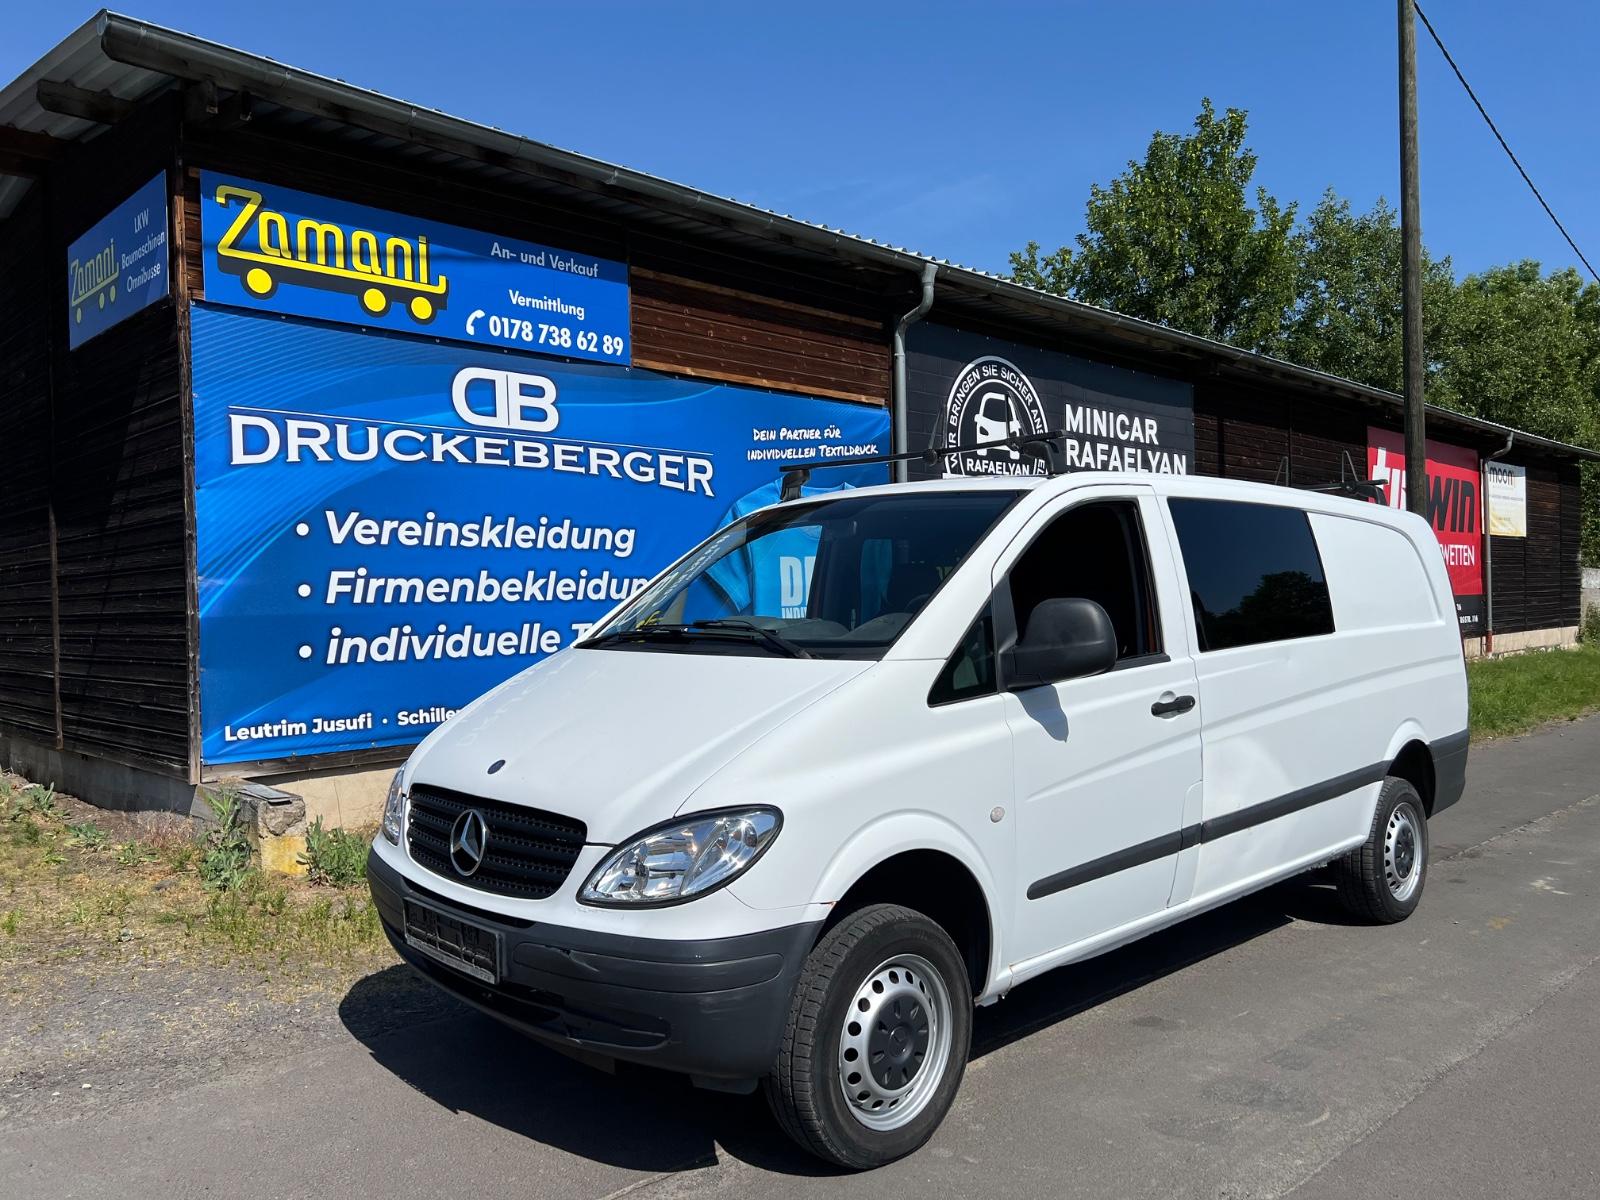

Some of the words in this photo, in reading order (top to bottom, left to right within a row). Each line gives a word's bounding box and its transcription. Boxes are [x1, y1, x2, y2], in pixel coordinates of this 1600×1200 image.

[134, 208, 149, 233] LKW
[216, 184, 446, 294] Zamani
[121, 231, 165, 269] Baumaschinen
[490, 242, 517, 260] An-
[520, 251, 545, 267] und
[549, 254, 599, 278] Verkauf
[71, 238, 119, 306] Zamani
[126, 262, 161, 293] Omnibusse
[508, 289, 585, 321] Vermittlung
[488, 315, 534, 342] 0178
[538, 323, 572, 348] 738
[576, 330, 598, 353] 62
[602, 334, 624, 356] 89
[949, 368, 981, 426] BRINGEN
[982, 365, 998, 377] SIE
[1000, 367, 1034, 406] SICHER
[1065, 403, 1159, 445] MINICAR
[228, 413, 715, 497] DRUCKEBERGER
[966, 458, 1030, 475] RAFAELYAN
[1065, 438, 1187, 475] RAFAELYAN
[325, 510, 637, 558] Vereinskleidung
[326, 567, 648, 604] Firmenbekleidun
[326, 623, 561, 665] individuelle
[571, 622, 594, 641] T
[224, 719, 307, 742] Leutrim
[312, 712, 373, 734] Jusufi
